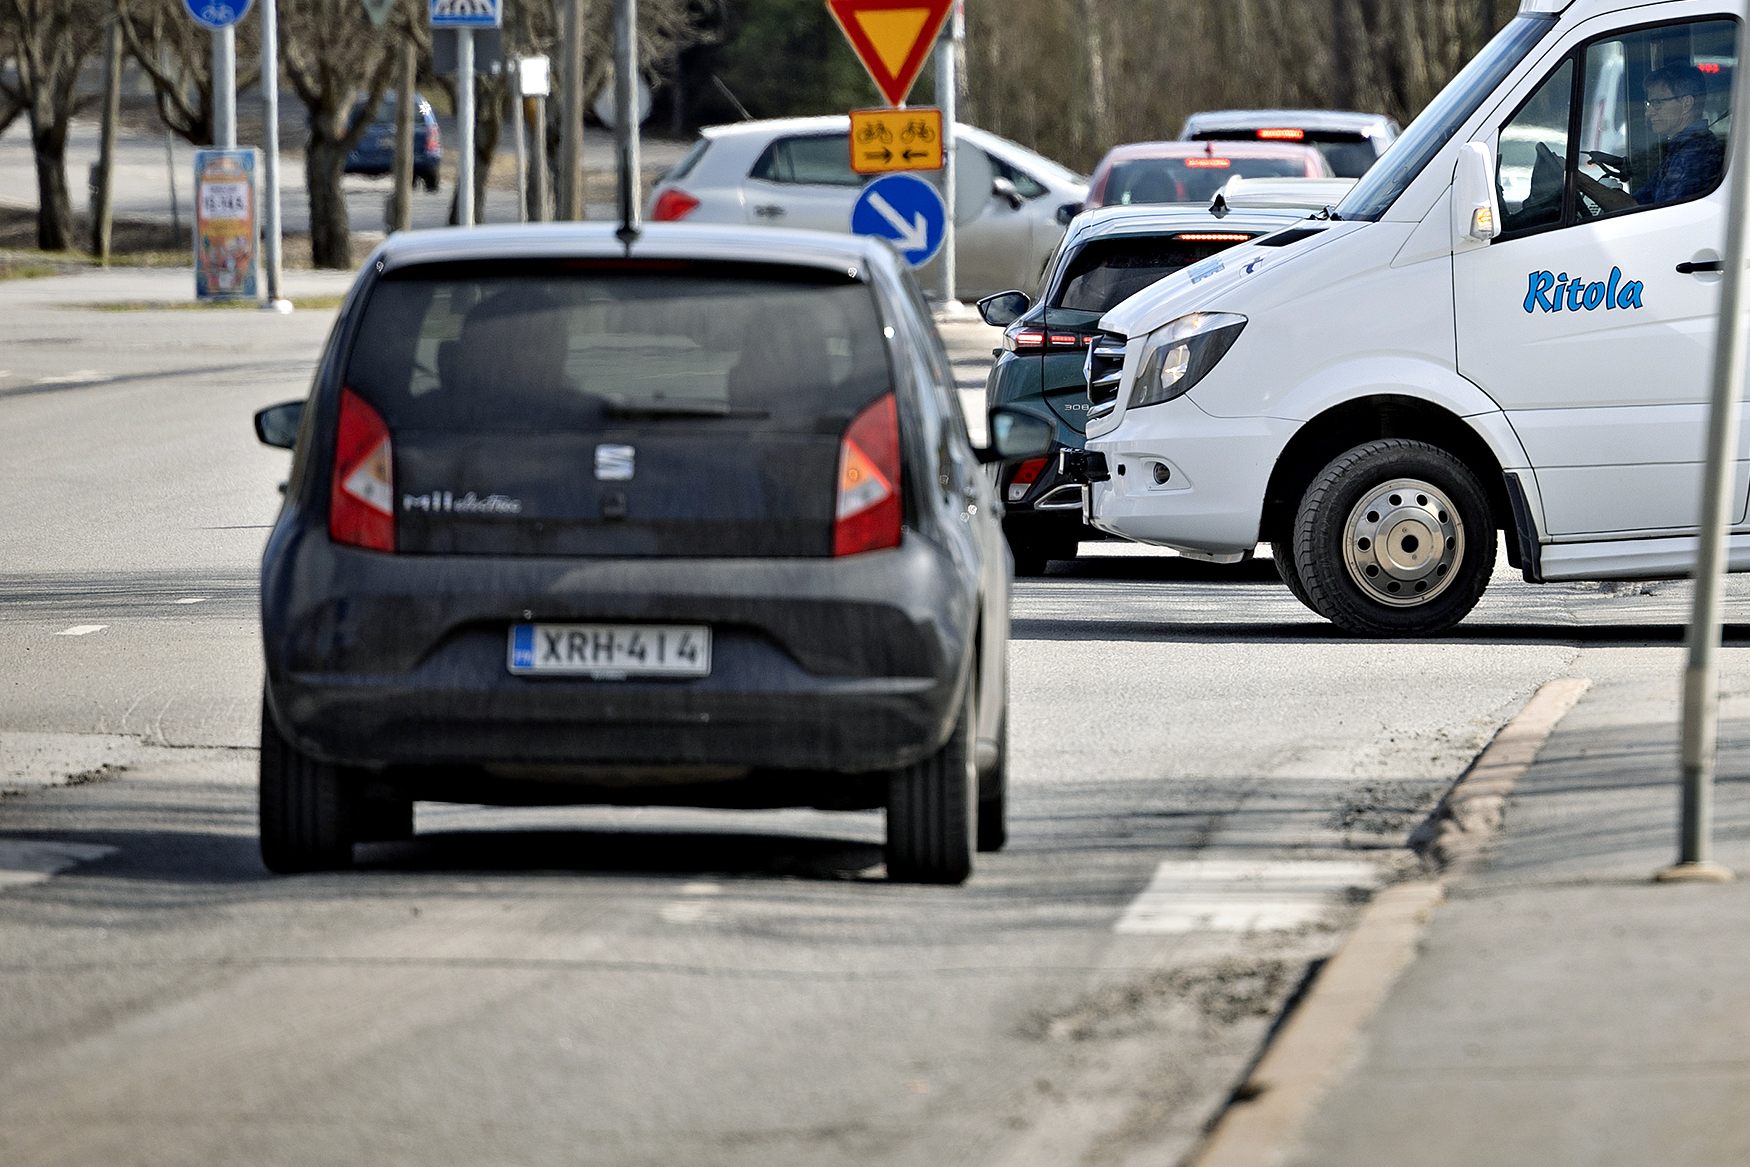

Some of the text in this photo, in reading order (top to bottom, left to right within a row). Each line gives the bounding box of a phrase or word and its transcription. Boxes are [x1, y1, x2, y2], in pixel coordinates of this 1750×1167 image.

[1522, 265, 1645, 314] Ritola
[1064, 403, 1090, 411] 308
[542, 629, 700, 665] XRH-414
